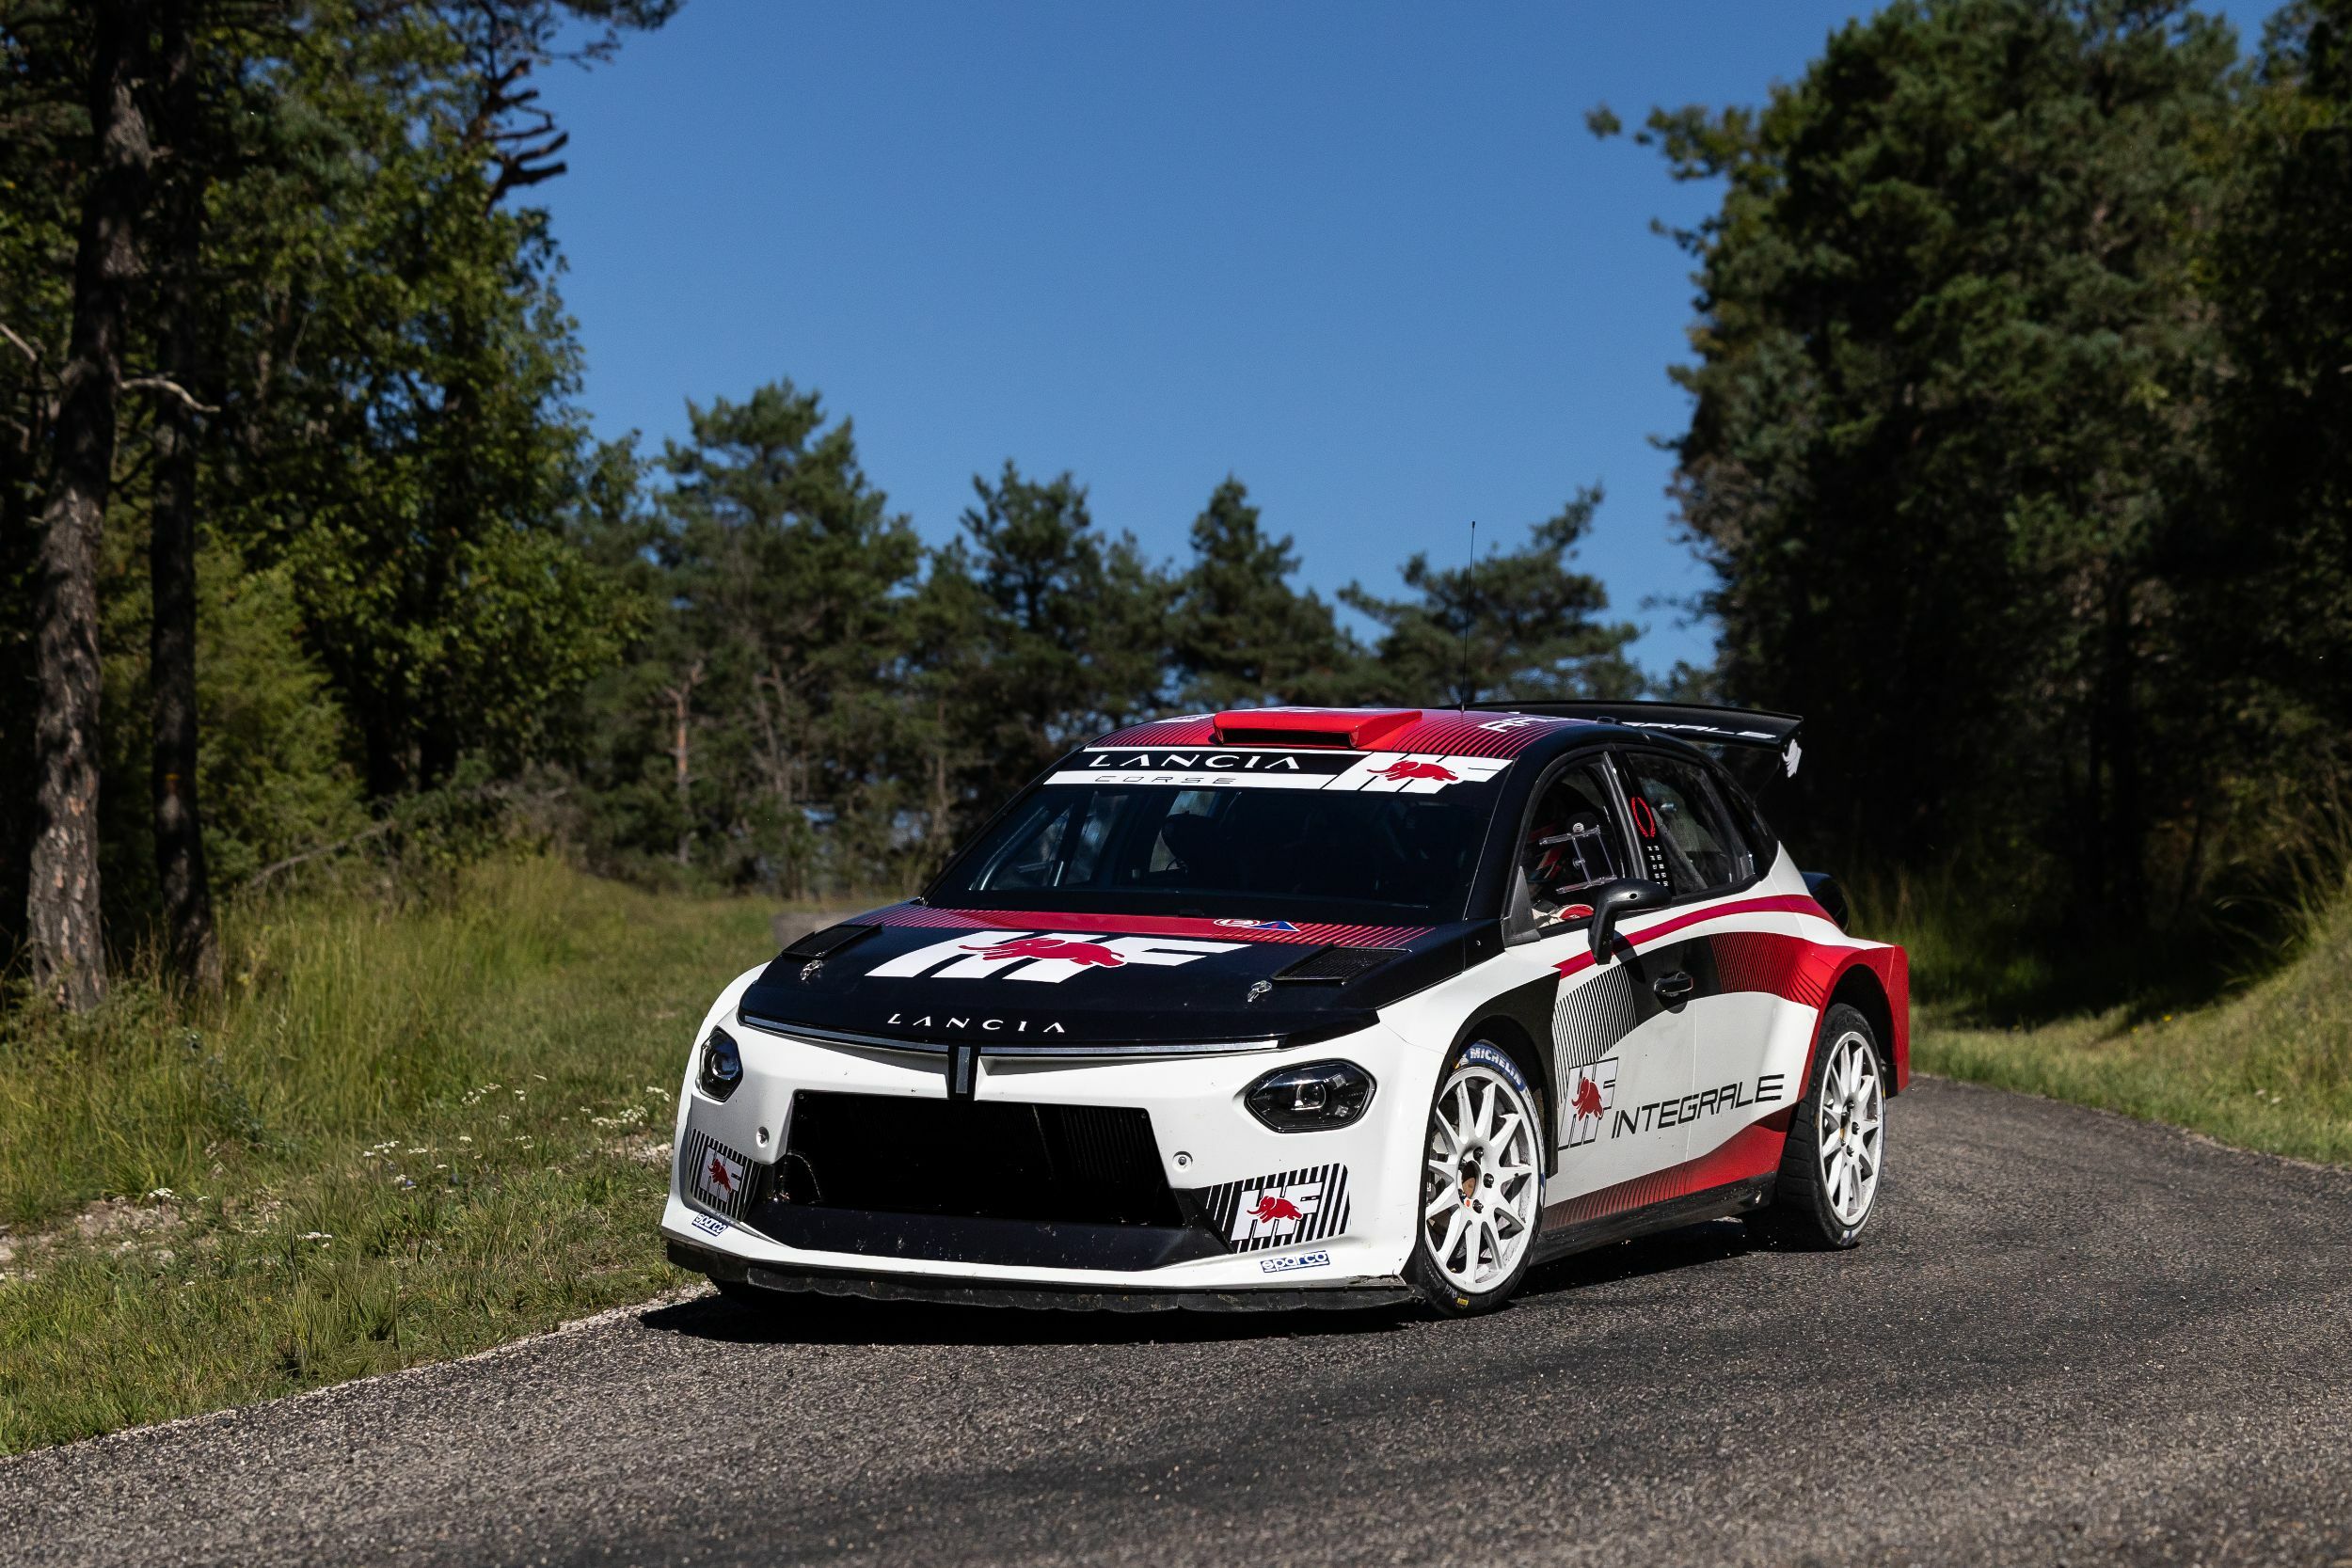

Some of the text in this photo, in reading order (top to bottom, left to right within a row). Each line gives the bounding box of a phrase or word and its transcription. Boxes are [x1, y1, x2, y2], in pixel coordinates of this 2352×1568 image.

[1089, 753, 1300, 769] LANCIA
[1095, 775, 1237, 784] CORSE
[887, 1013, 1065, 1034] LANCIA
[1470, 1047, 1522, 1086] MICHELIN
[1611, 1073, 1785, 1139] INTEGRALE
[693, 1213, 728, 1236] sparco
[1262, 1251, 1330, 1273] sparco
